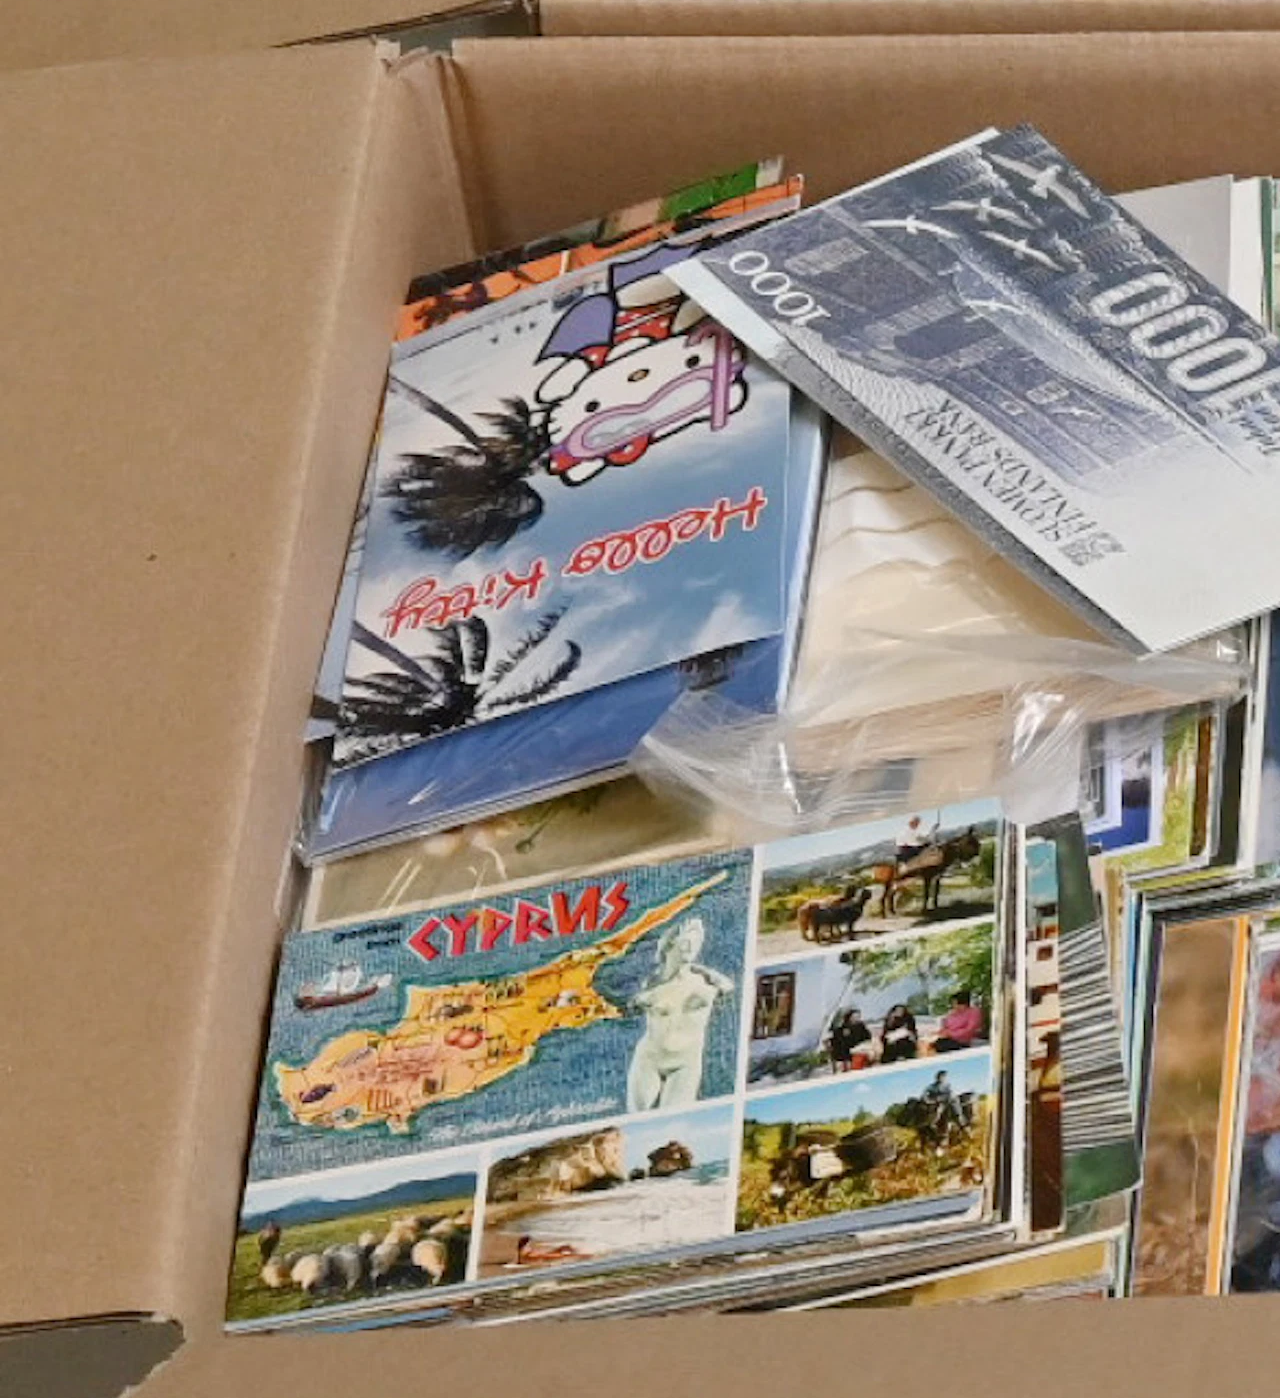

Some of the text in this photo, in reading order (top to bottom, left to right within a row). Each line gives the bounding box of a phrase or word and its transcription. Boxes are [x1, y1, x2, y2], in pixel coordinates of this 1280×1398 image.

[729, 250, 832, 326] 1000
[384, 485, 768, 639] Hello Kitty
[406, 881, 632, 963] CYPRUS
